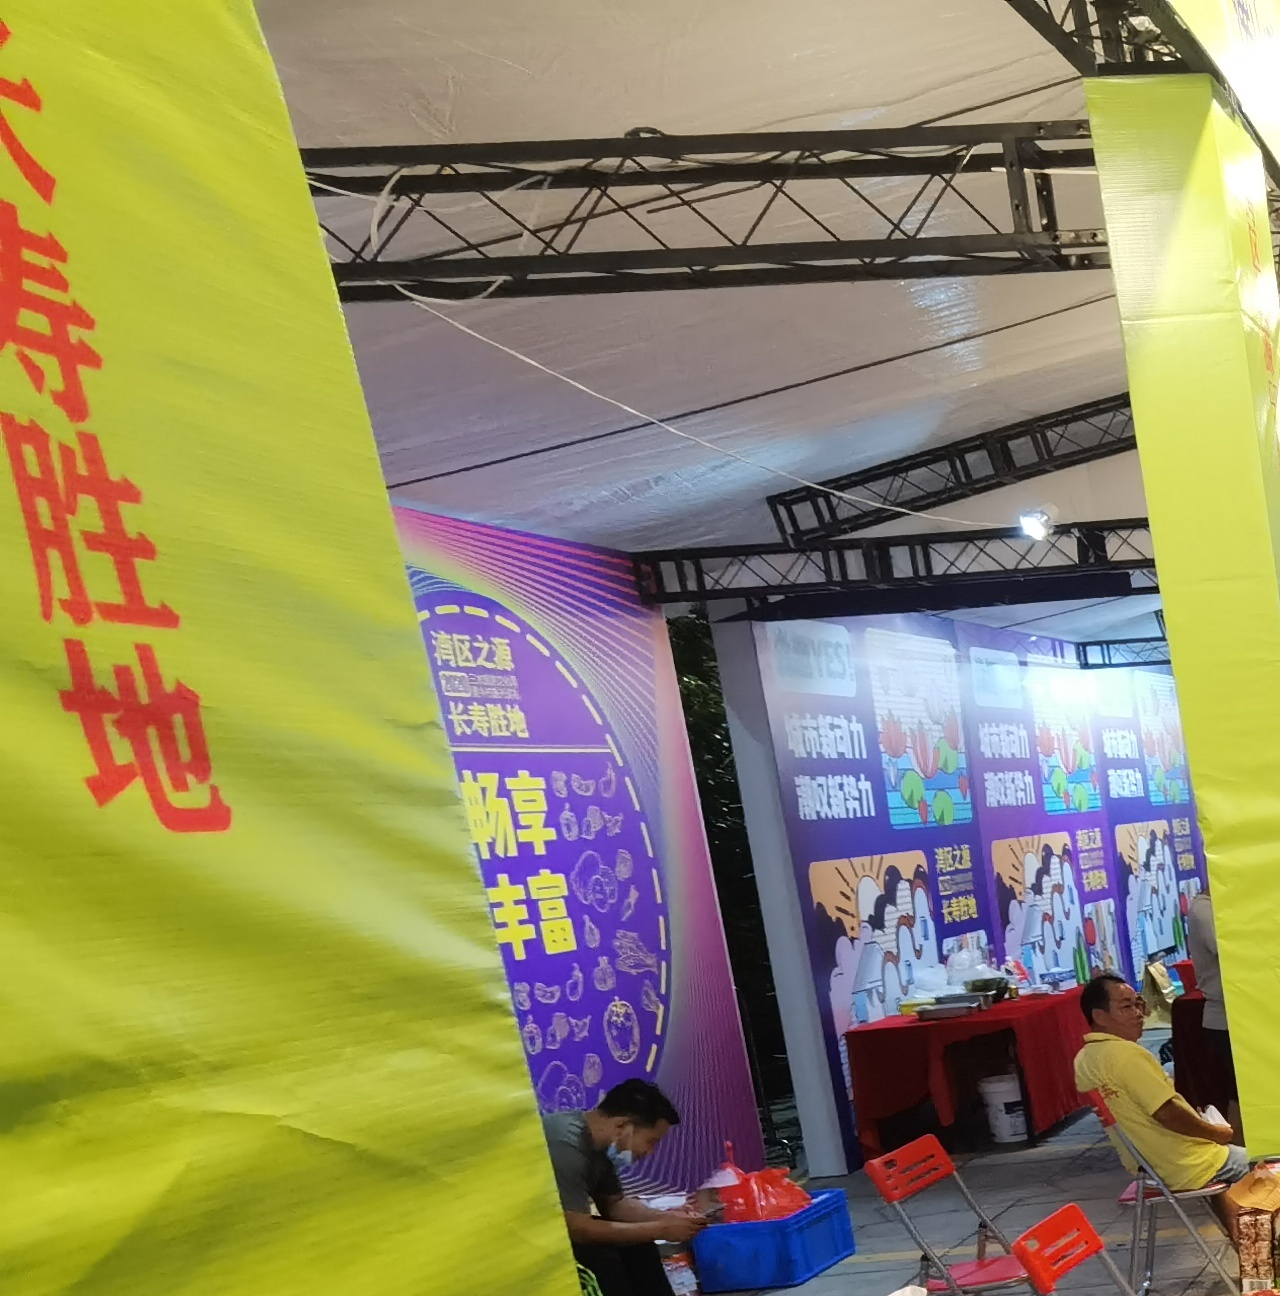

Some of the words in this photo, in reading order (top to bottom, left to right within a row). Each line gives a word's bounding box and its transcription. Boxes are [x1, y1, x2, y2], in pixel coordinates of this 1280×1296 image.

[448, 701, 530, 738] 长寿胜地
[460, 770, 557, 859] 畅享
